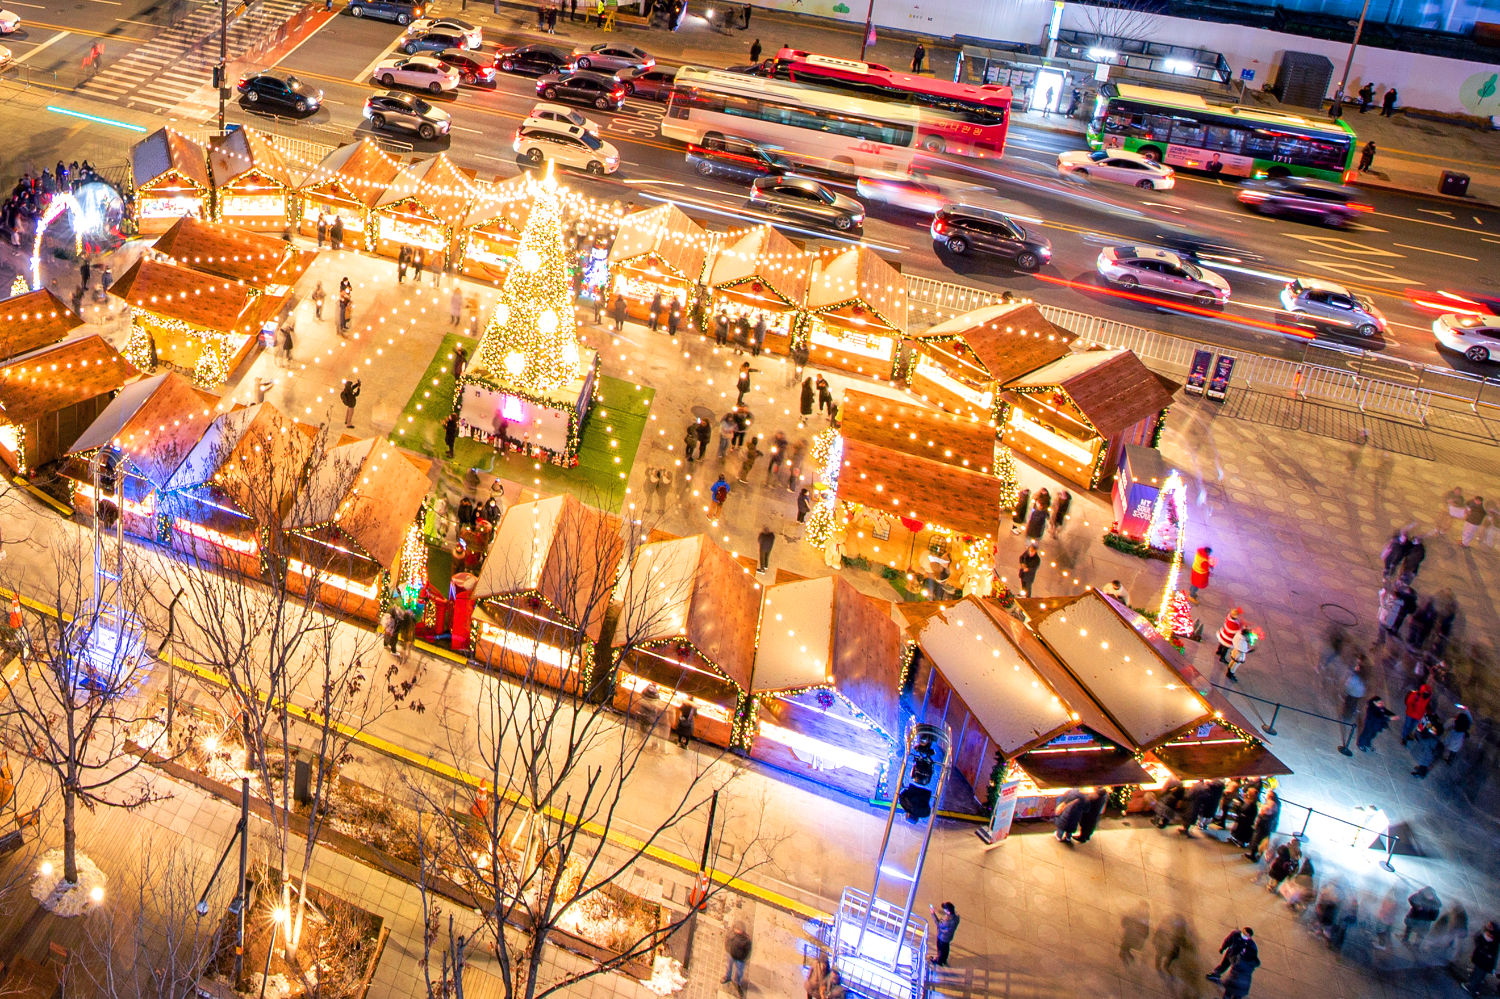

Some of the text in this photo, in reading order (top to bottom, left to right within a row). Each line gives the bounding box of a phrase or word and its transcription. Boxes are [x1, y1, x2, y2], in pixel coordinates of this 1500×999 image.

[938, 121, 983, 136] 하나관광
[1272, 154, 1293, 164] 1711
[1140, 498, 1152, 506] MY
